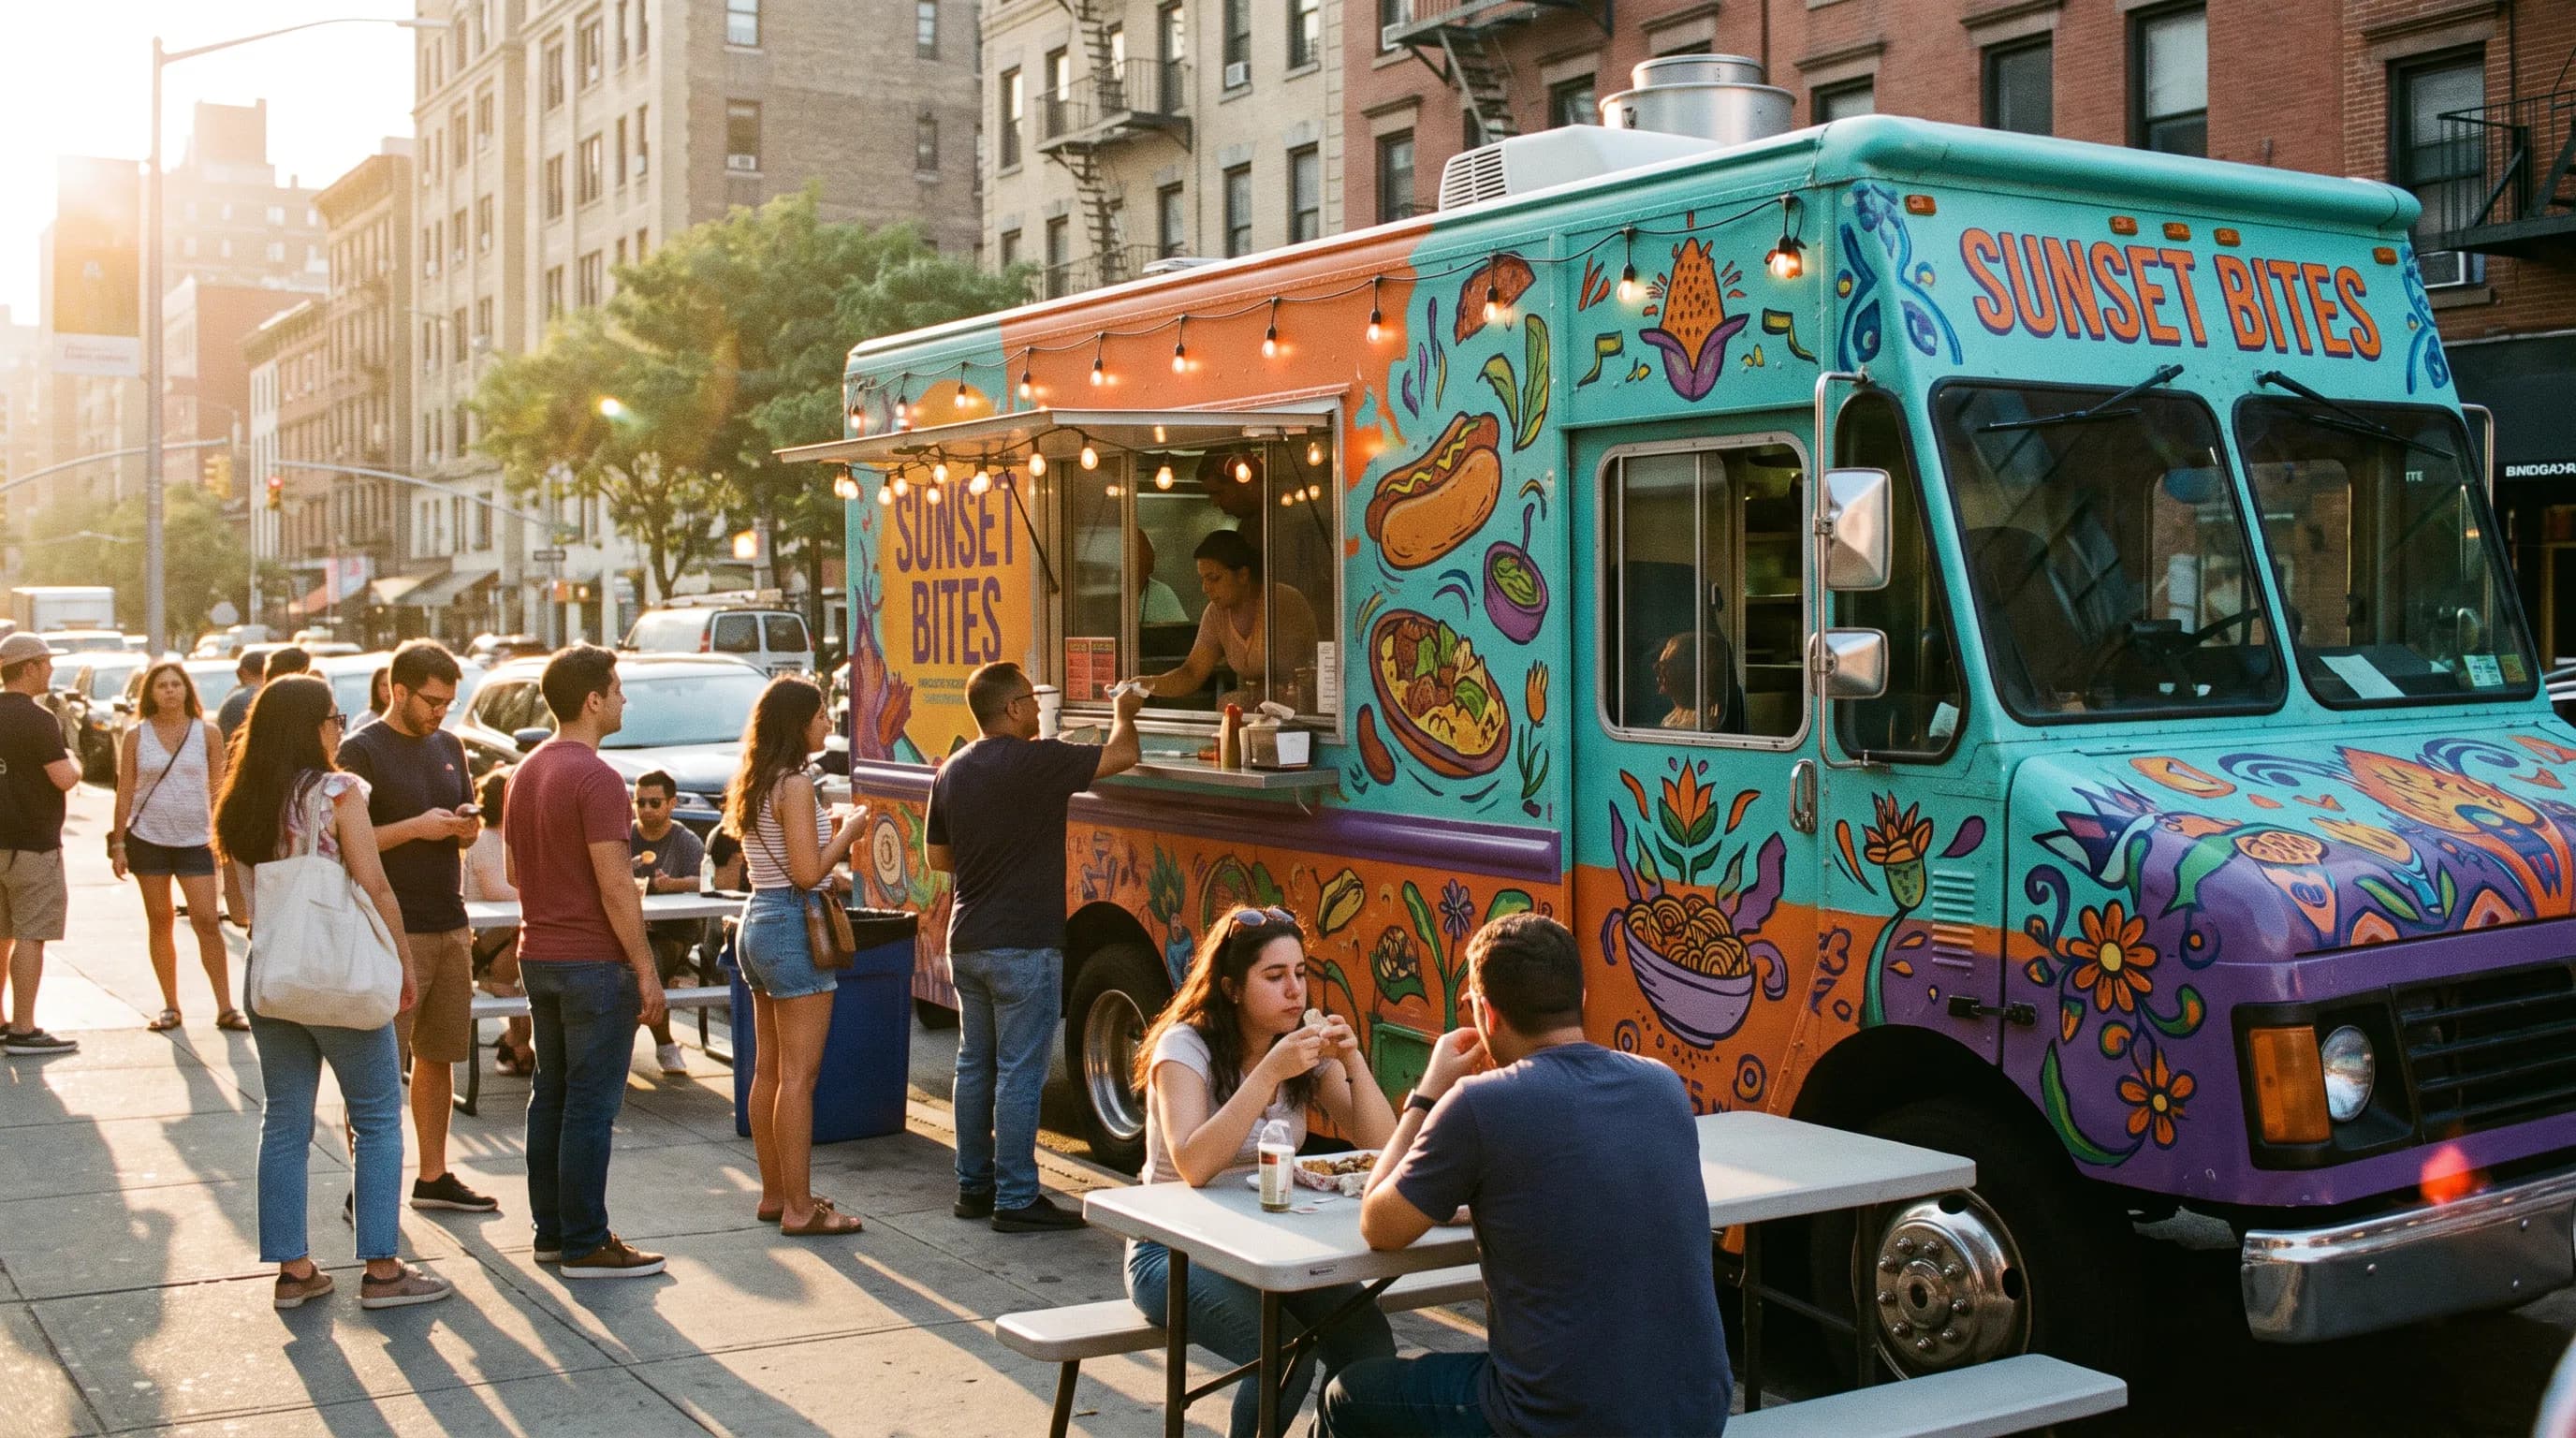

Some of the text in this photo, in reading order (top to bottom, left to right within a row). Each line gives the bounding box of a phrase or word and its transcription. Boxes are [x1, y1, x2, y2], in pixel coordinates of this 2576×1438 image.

[1960, 227, 2382, 361] SUNSET BITES
[896, 473, 1017, 573] SUNSET
[912, 576, 1002, 665] BITES
